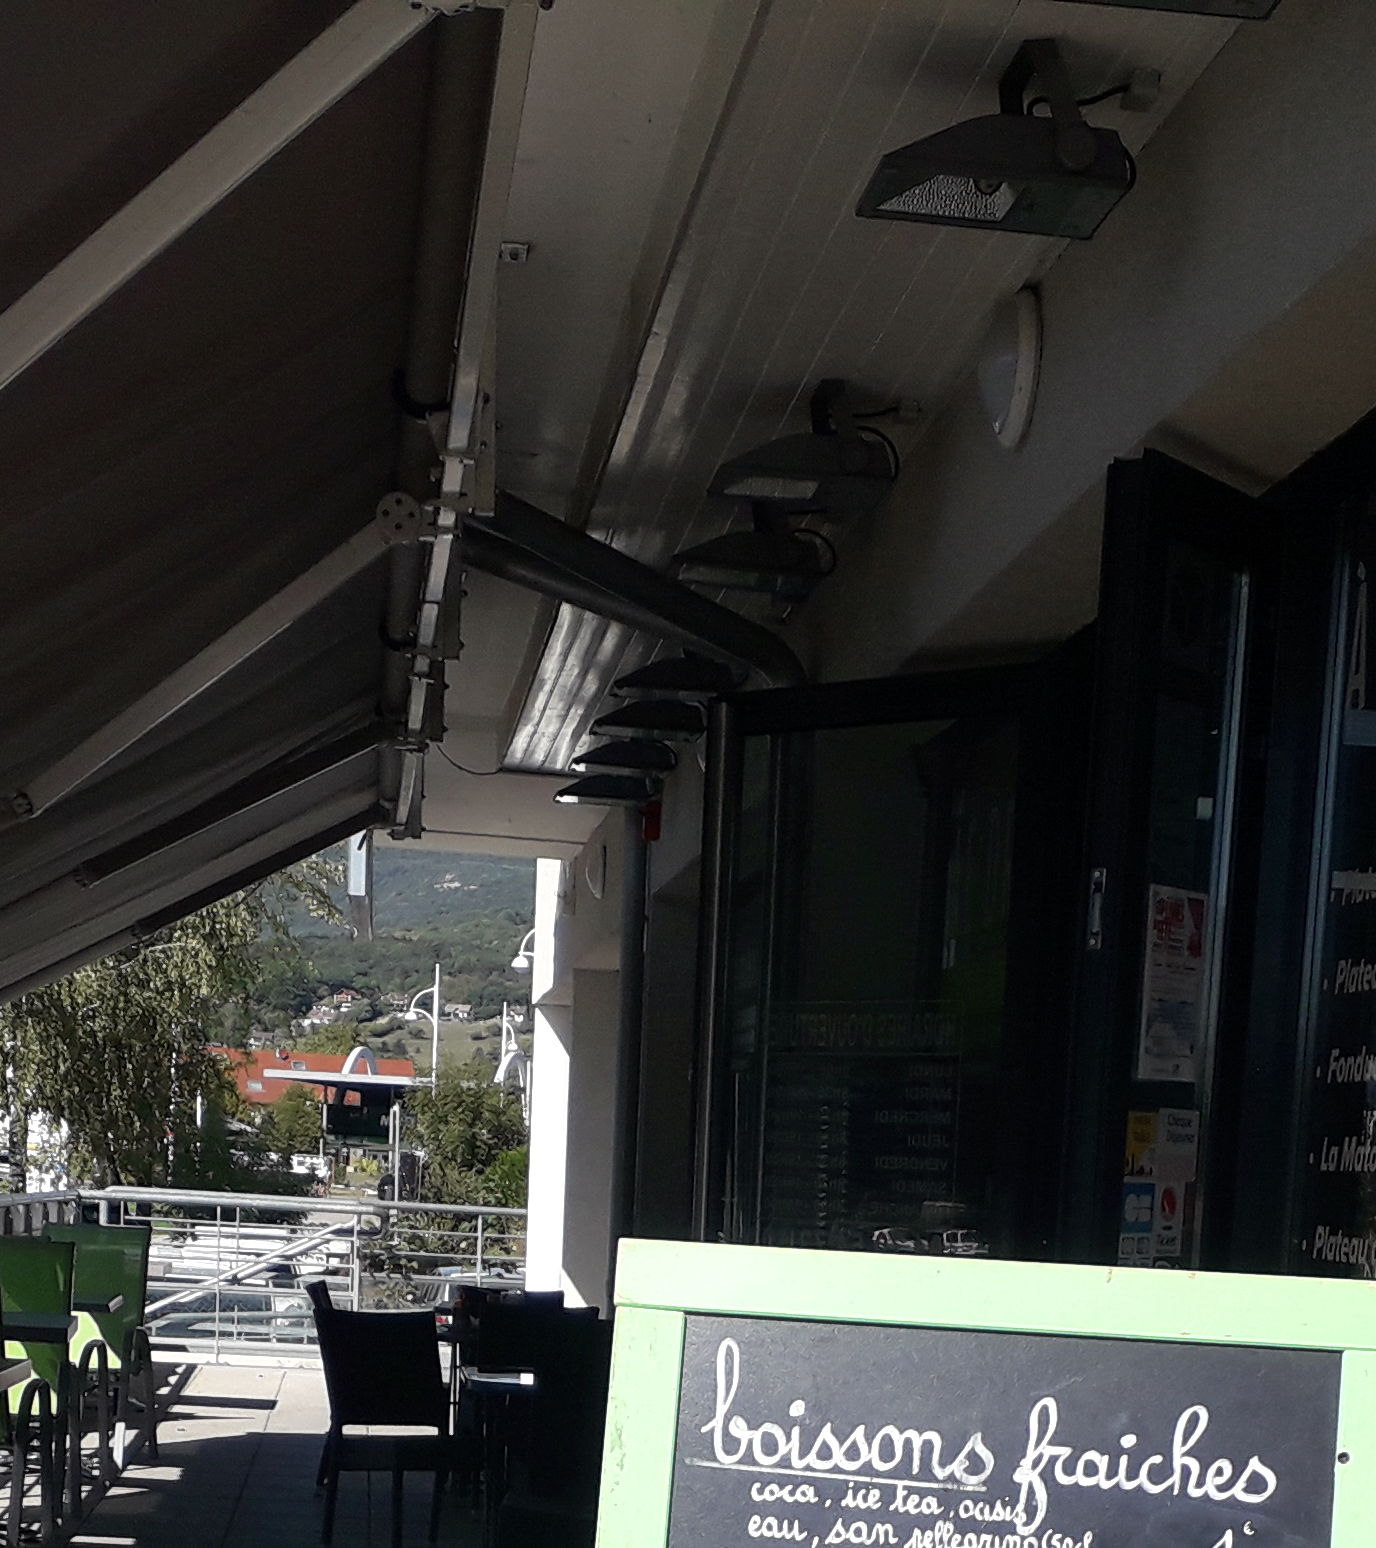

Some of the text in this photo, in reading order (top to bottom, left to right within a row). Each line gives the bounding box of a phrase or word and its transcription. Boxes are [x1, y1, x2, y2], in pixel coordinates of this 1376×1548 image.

[1320, 1137, 1338, 1172] La
[1312, 1225, 1368, 1266] Plateau
[700, 1337, 1278, 1536] boissons fraiches
[840, 1482, 883, 1511] ice
[959, 1497, 1027, 1524] oasis
[824, 1518, 899, 1545] san
